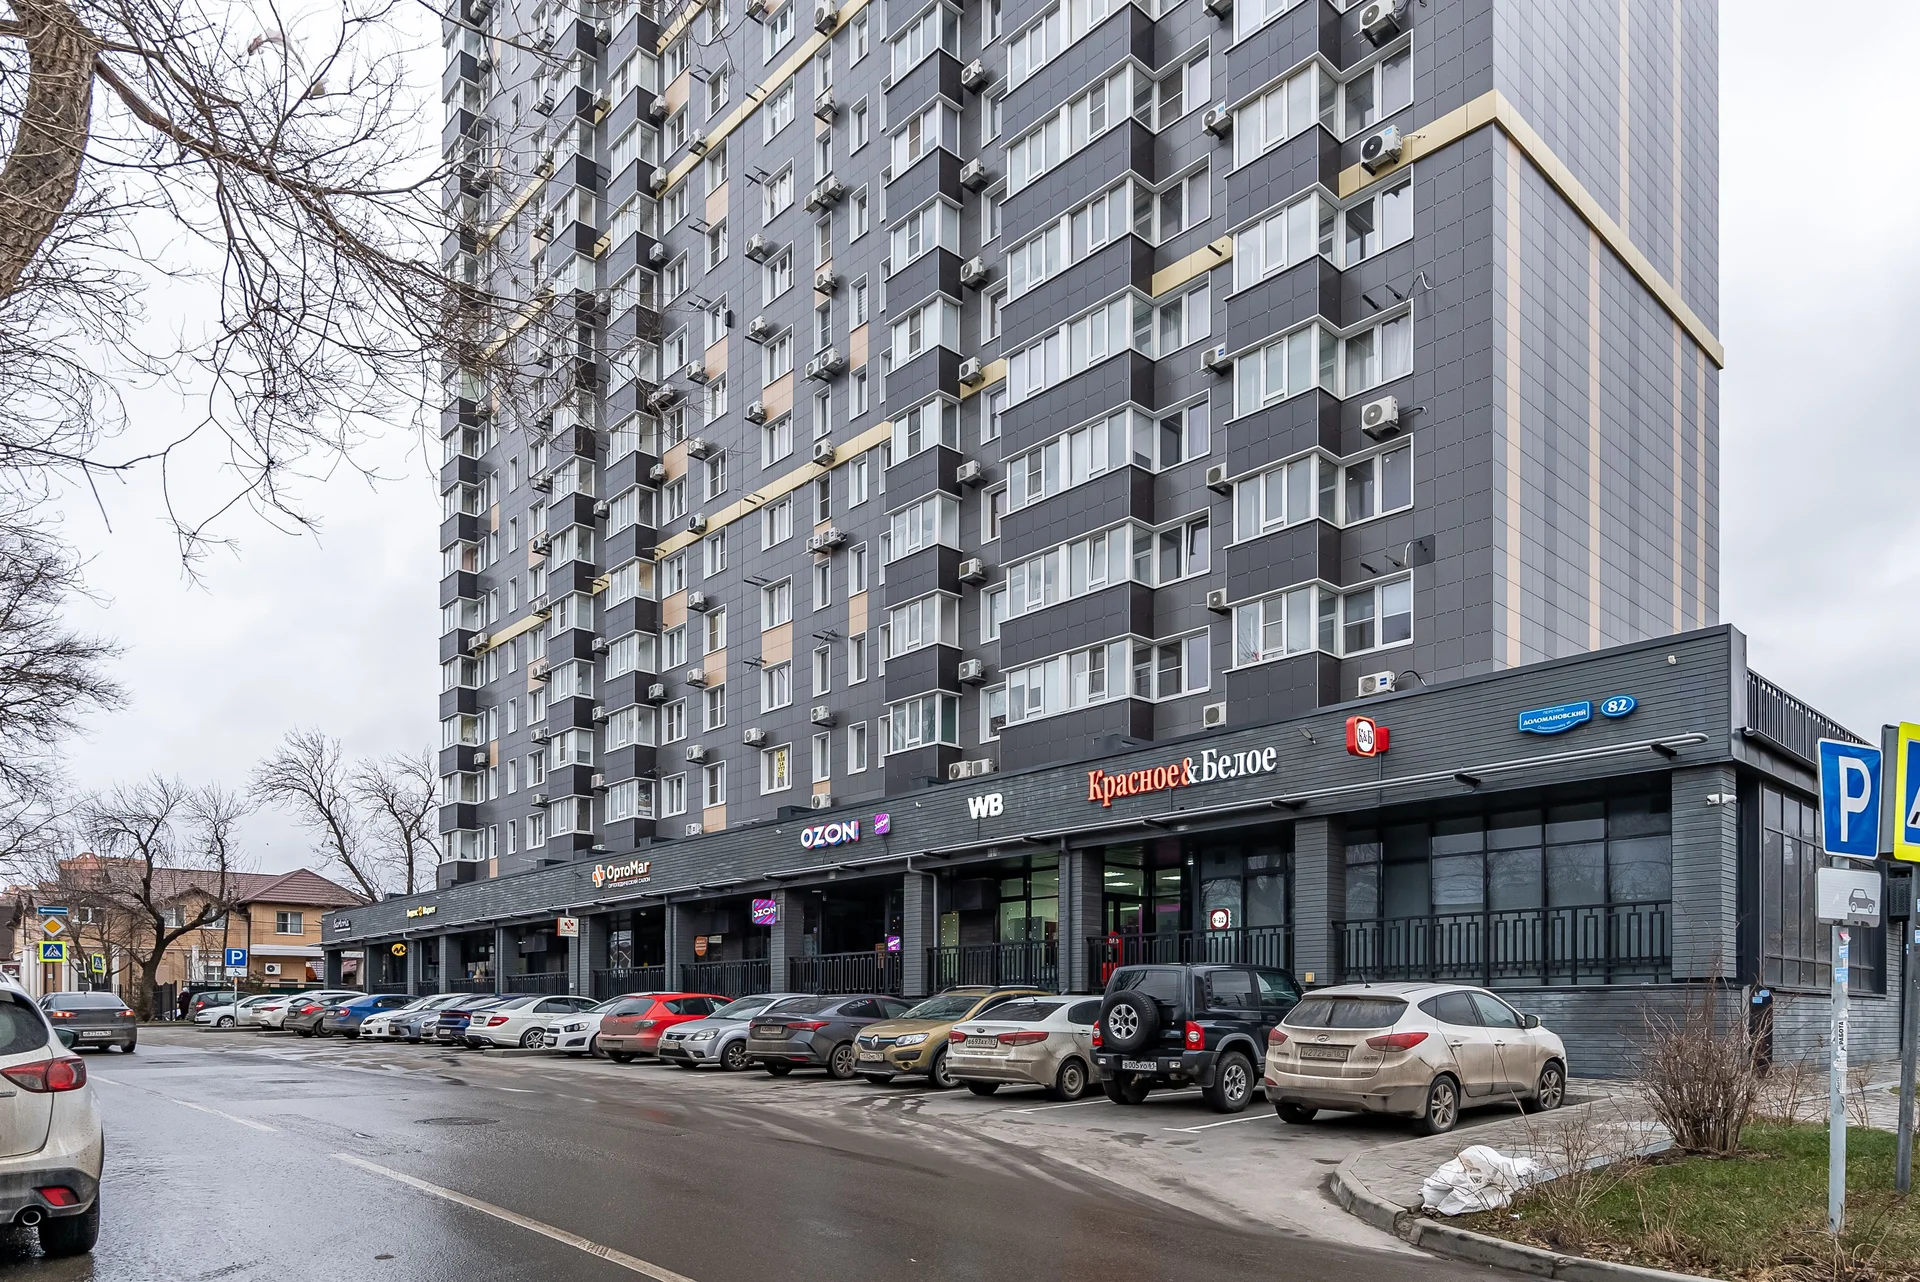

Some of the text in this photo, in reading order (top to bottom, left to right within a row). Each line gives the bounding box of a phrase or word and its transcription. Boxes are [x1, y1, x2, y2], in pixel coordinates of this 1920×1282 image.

[1523, 709, 1587, 726] ДОЛОМАНОВСКИЙ
[1607, 699, 1627, 712] 82
[1087, 746, 1278, 808] Красное&Белое
[967, 793, 1004, 820] WB
[800, 820, 860, 849] OZON
[606, 860, 651, 881] ОртоМаг
